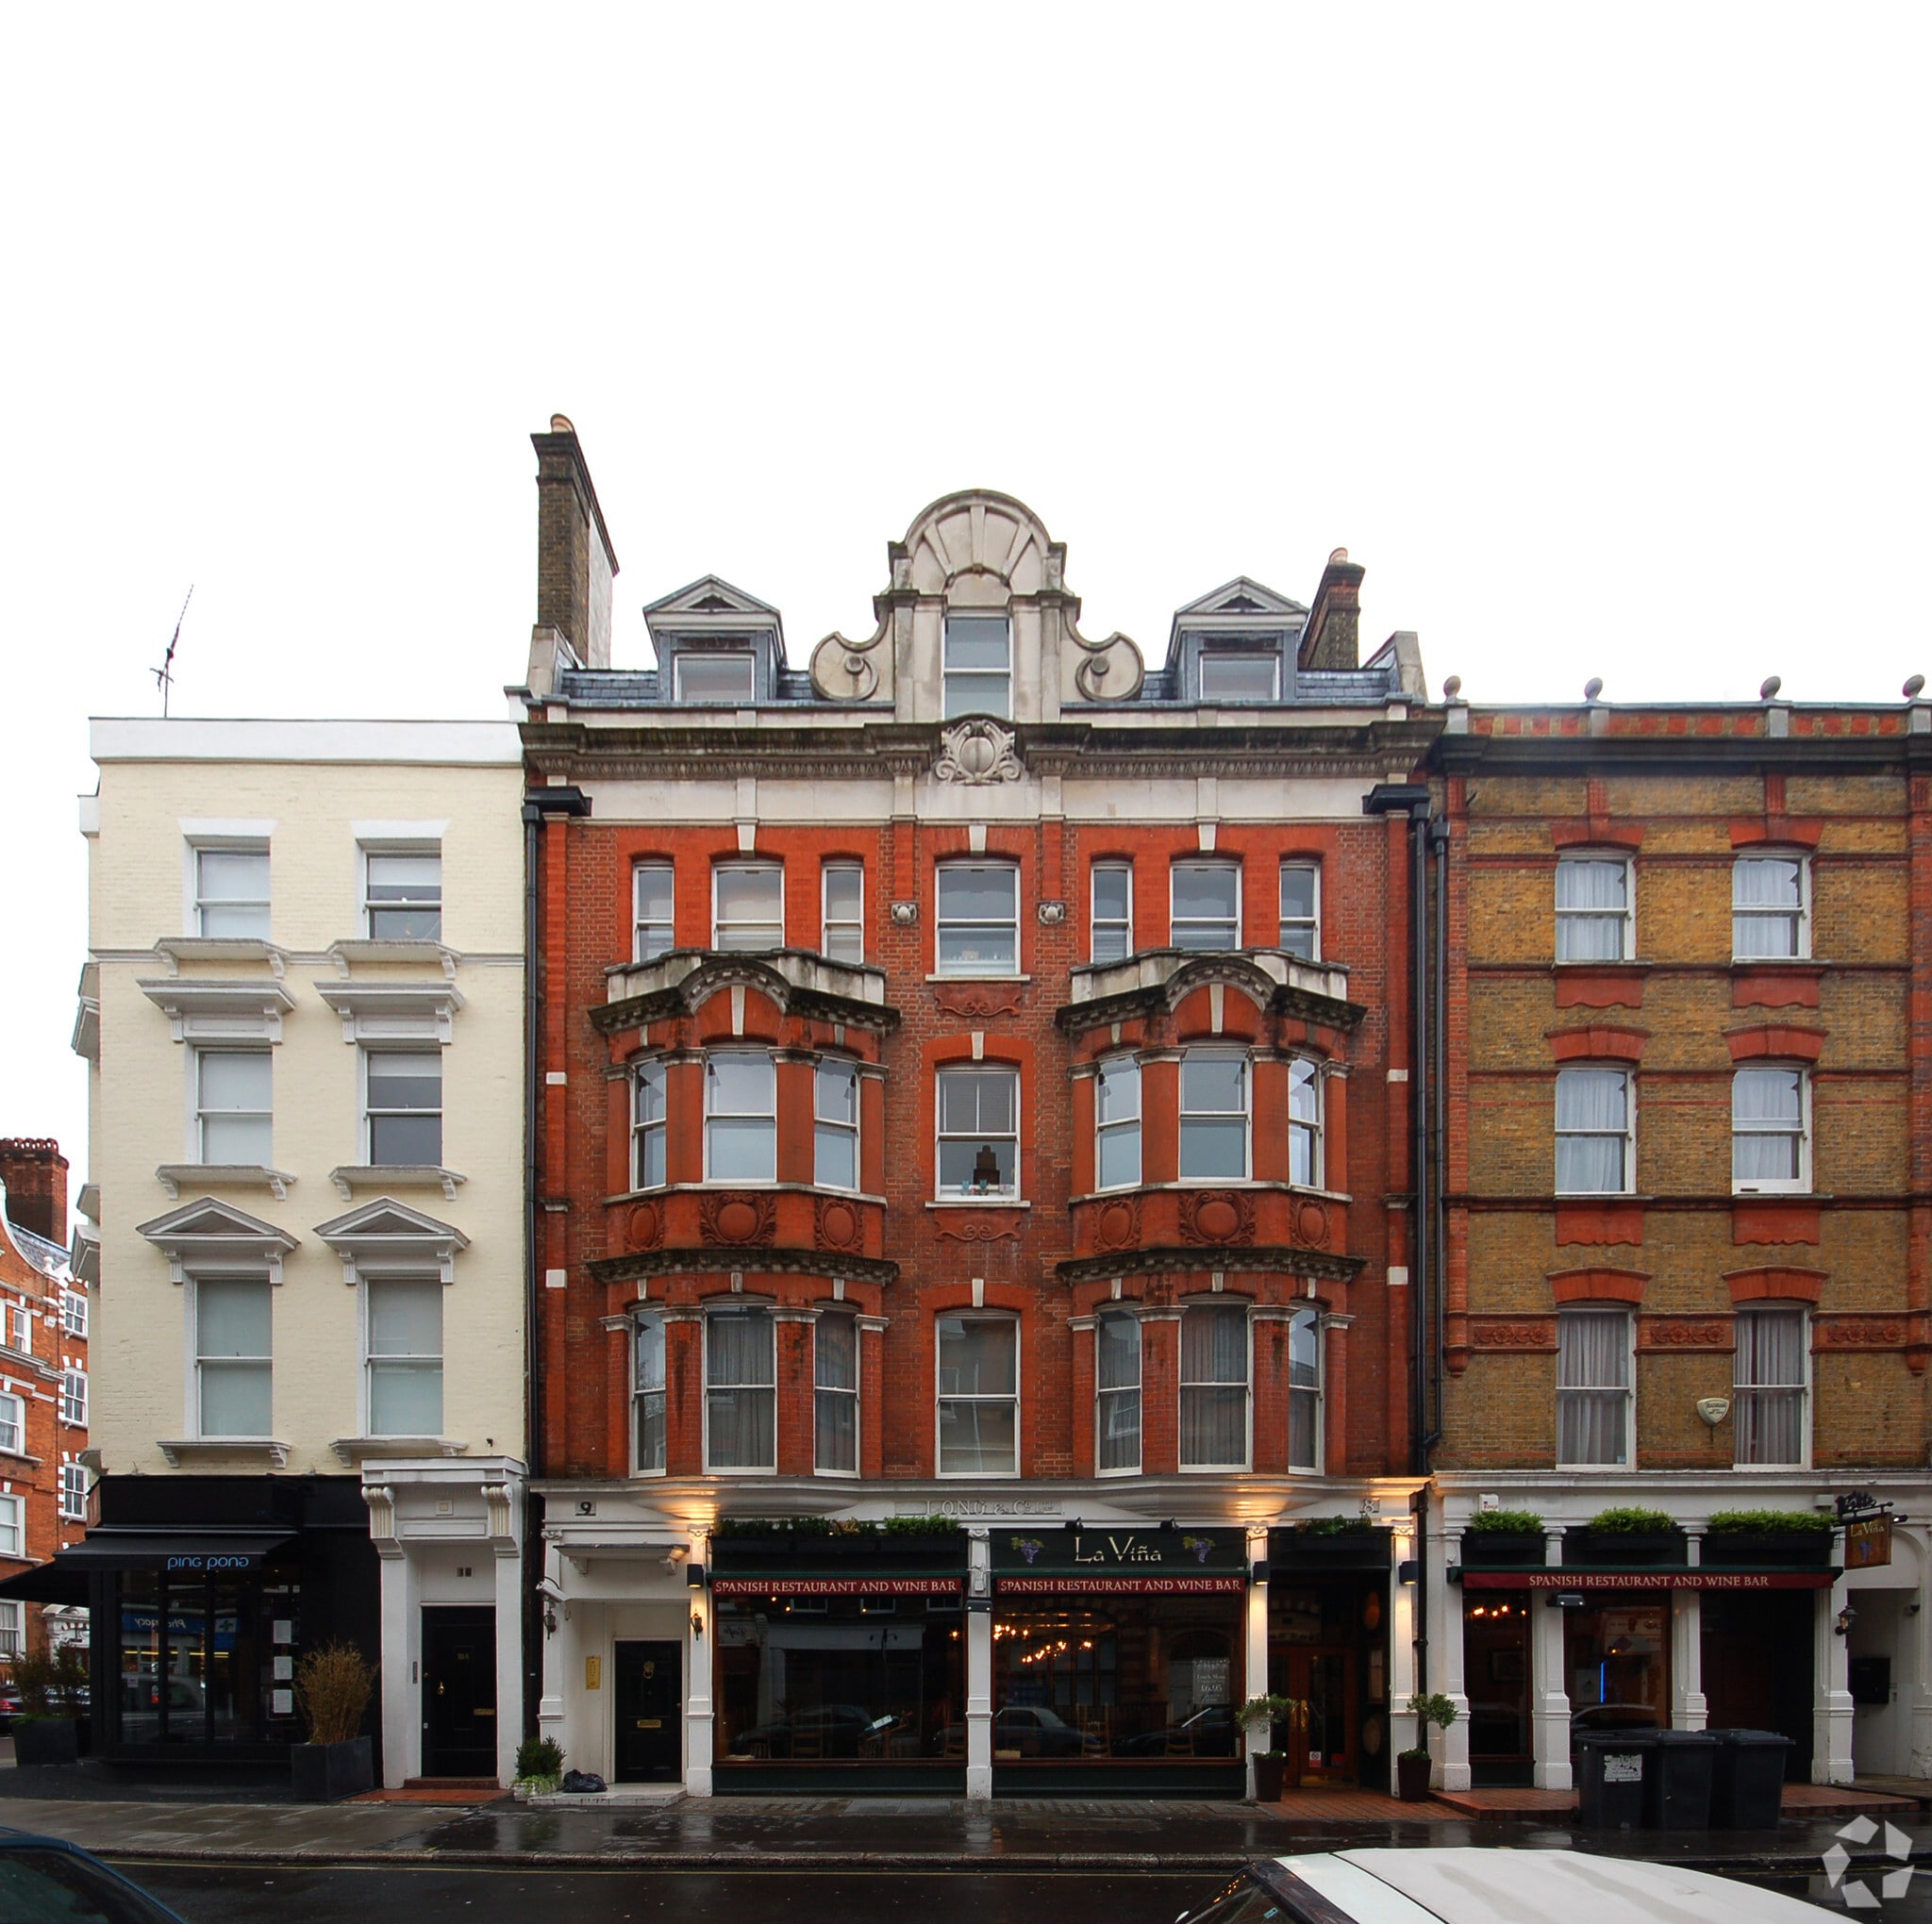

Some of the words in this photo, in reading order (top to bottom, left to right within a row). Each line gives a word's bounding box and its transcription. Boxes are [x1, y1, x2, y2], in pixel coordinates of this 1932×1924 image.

[580, 1501, 591, 1517] 9
[925, 1500, 987, 1517] LONG
[993, 1501, 1008, 1516] &
[1363, 1498, 1374, 1514] 8
[1850, 1524, 1863, 1537] La
[1074, 1536, 1105, 1564] La
[1108, 1536, 1161, 1562] Viña
[167, 1556, 202, 1570] ping
[207, 1556, 249, 1570] pong
[715, 1582, 769, 1593] SPANISH
[773, 1582, 858, 1593] RESTAURANT
[859, 1582, 890, 1593] AND
[892, 1582, 928, 1593] WINE
[931, 1582, 957, 1593] BAR
[1000, 1580, 1054, 1592] SPANISH
[1058, 1580, 1142, 1592] RESTAURANT
[1144, 1580, 1174, 1592] AND
[1176, 1580, 1213, 1592] WINE
[1215, 1580, 1241, 1592] BAR
[1529, 1576, 1583, 1587] SPANISH
[1586, 1576, 1671, 1587] RESTAURANT
[1673, 1576, 1702, 1587] AND
[1706, 1576, 1741, 1587] WINE
[1744, 1576, 1770, 1587] BAR
